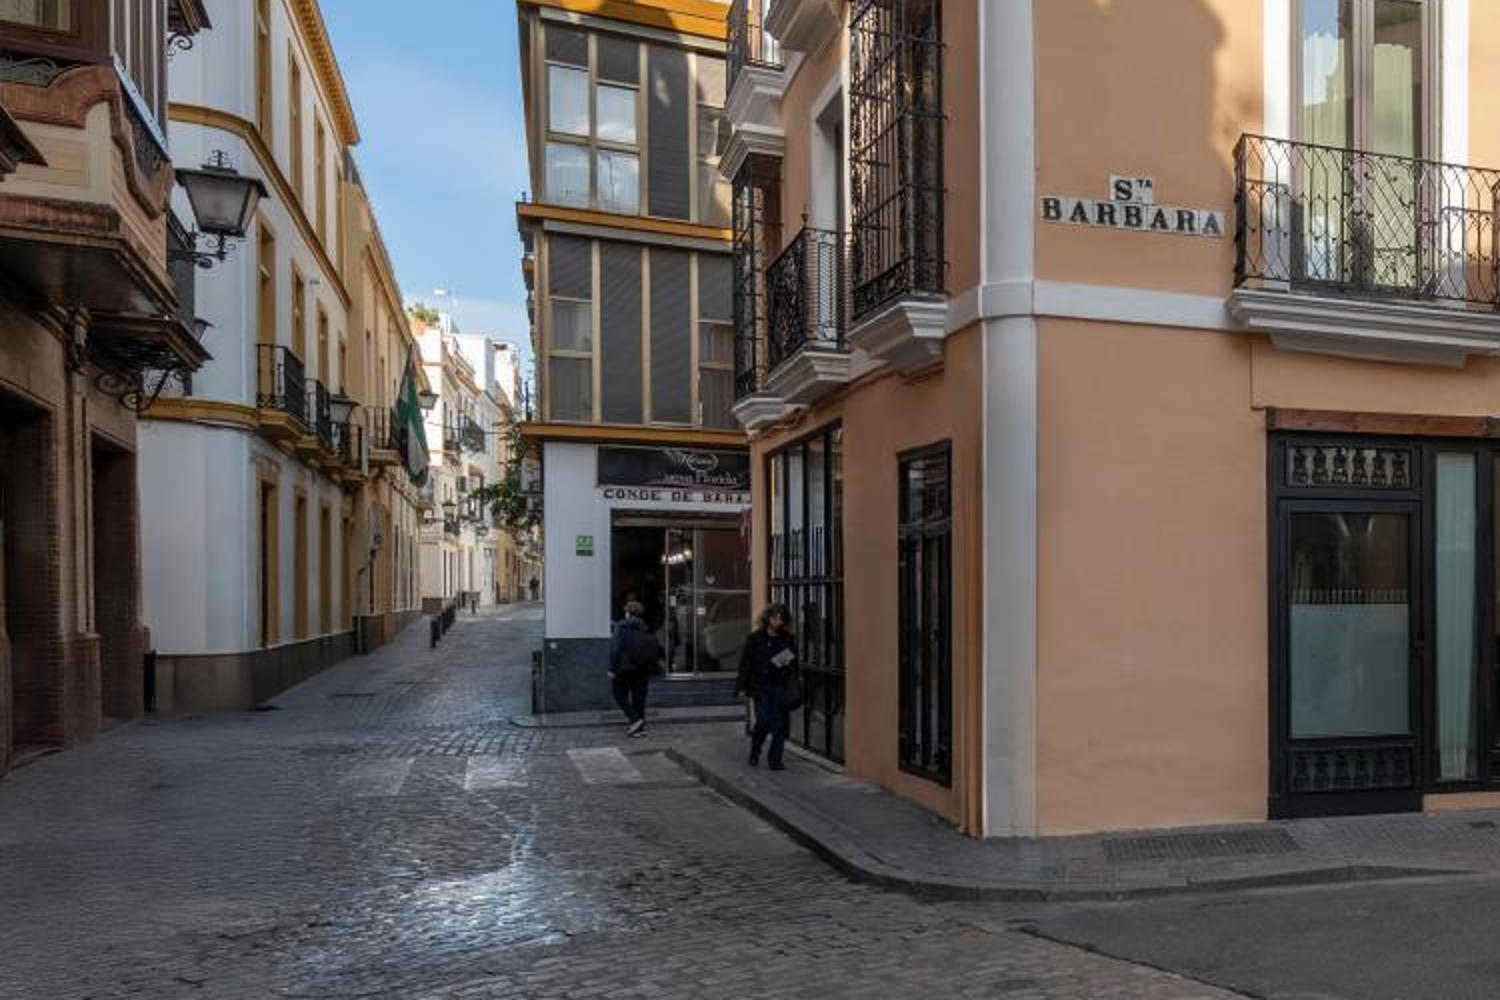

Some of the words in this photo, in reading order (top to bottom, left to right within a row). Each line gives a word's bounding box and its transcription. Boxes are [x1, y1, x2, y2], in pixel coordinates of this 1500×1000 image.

[1042, 197, 1221, 234] BARBARA
[603, 488, 661, 501] CONDE
[671, 490, 691, 502] DE
